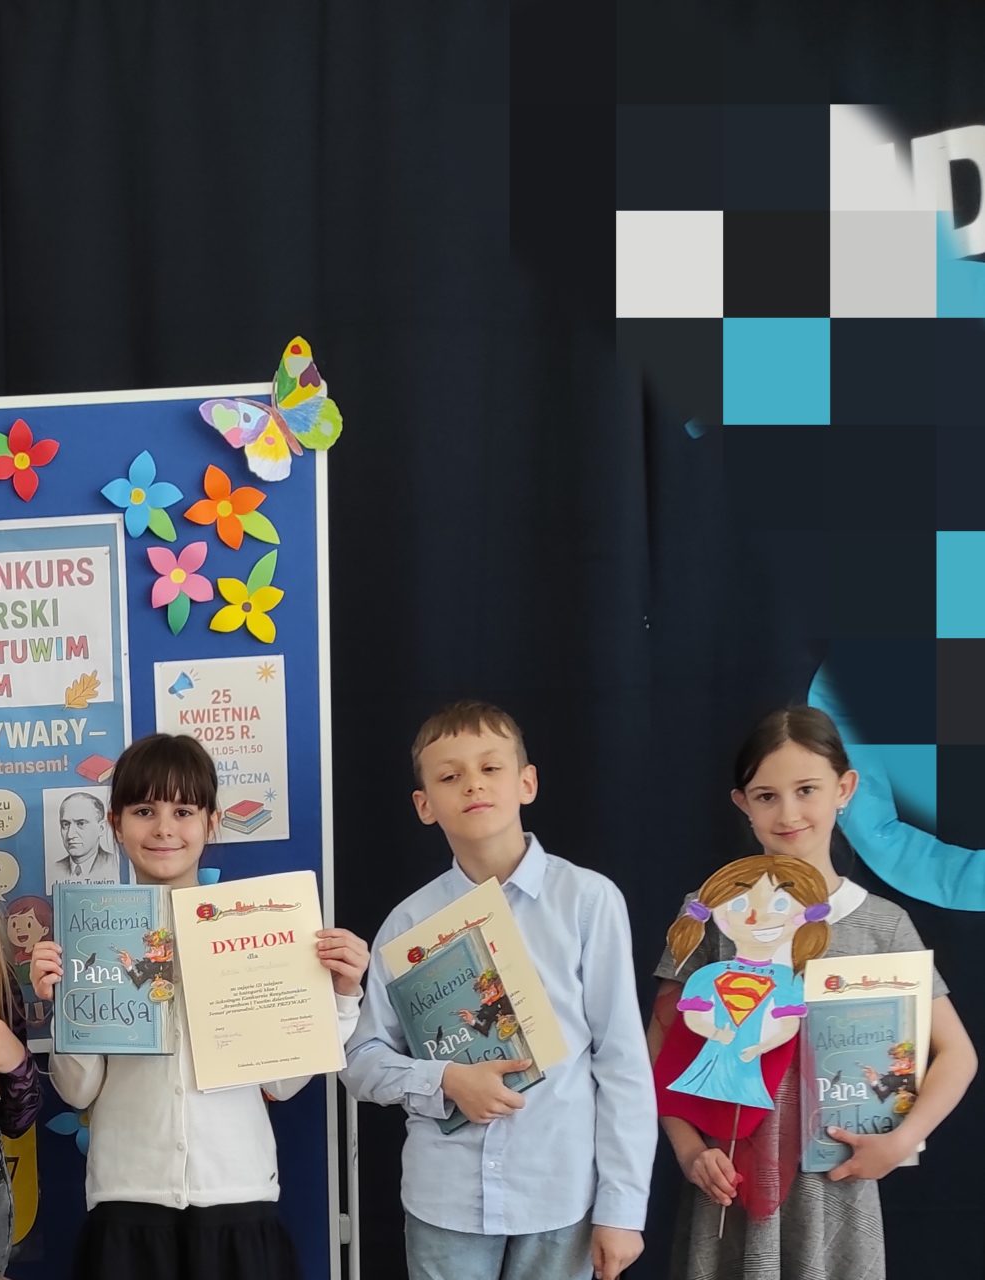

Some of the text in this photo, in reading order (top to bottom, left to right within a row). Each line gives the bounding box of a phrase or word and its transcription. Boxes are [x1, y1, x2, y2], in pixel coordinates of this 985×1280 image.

[211, 689, 232, 705] 25
[179, 706, 261, 725] KWIETNIA
[193, 724, 256, 742] 2025 R.
[217, 760, 239, 771] ALA
[218, 772, 271, 786] STYCZNA
[69, 909, 151, 933] Akademia
[211, 930, 295, 955] DYPLOM
[246, 952, 259, 960] dla
[71, 958, 124, 984] Pana
[409, 967, 476, 1018] Akademia
[71, 989, 152, 1026] Kleksa
[423, 1027, 474, 1060] Pana
[816, 1025, 896, 1050] Akademia
[816, 1077, 869, 1102] Pana
